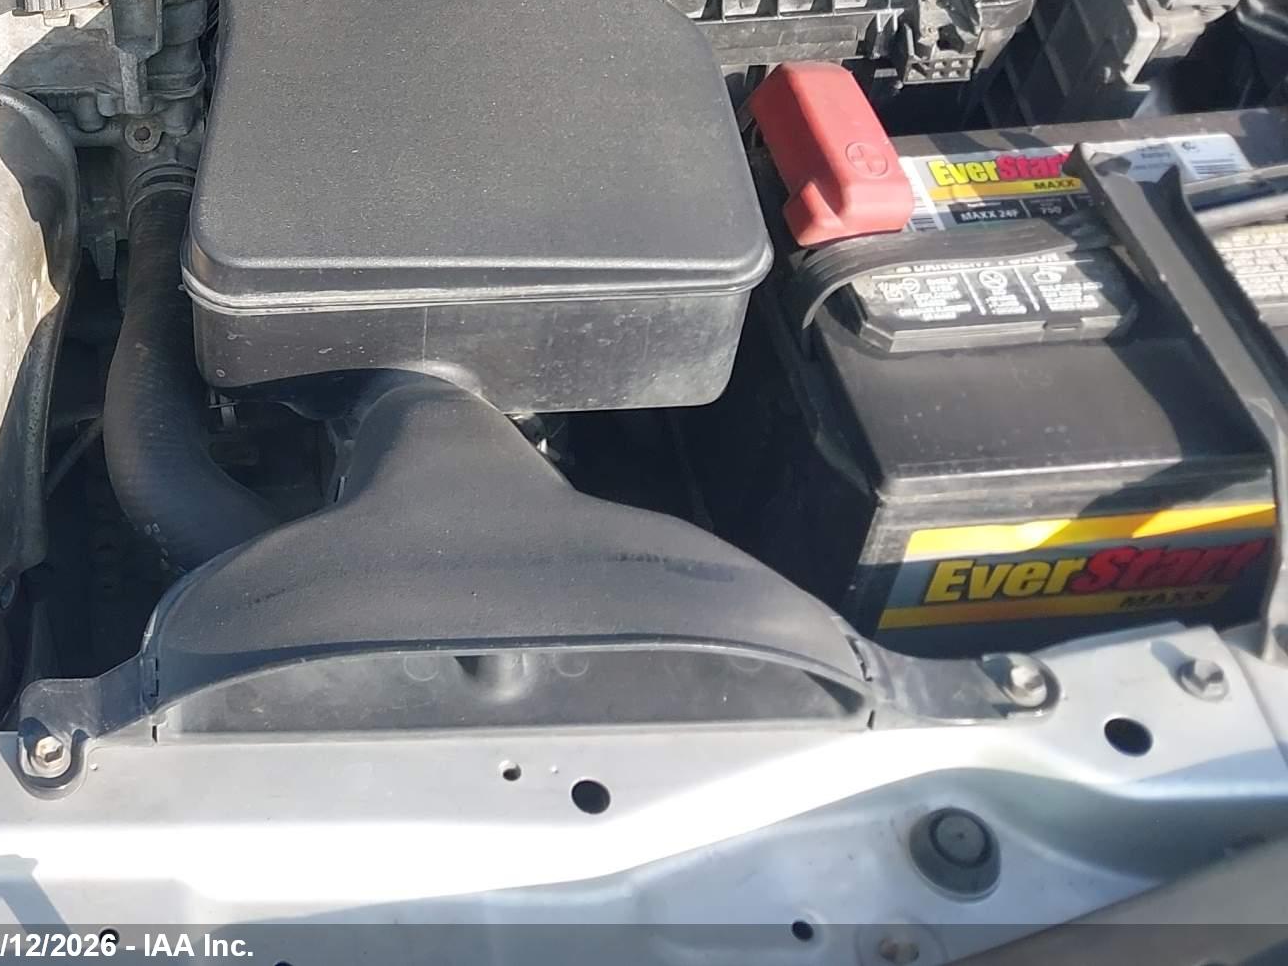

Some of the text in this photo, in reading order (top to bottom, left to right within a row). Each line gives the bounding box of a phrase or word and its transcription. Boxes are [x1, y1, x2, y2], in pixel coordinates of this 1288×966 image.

[1033, 179, 1076, 190] MAXX
[960, 209, 997, 221] MAXX
[924, 537, 1272, 604] EverStart
[1119, 587, 1212, 609] MAXX
